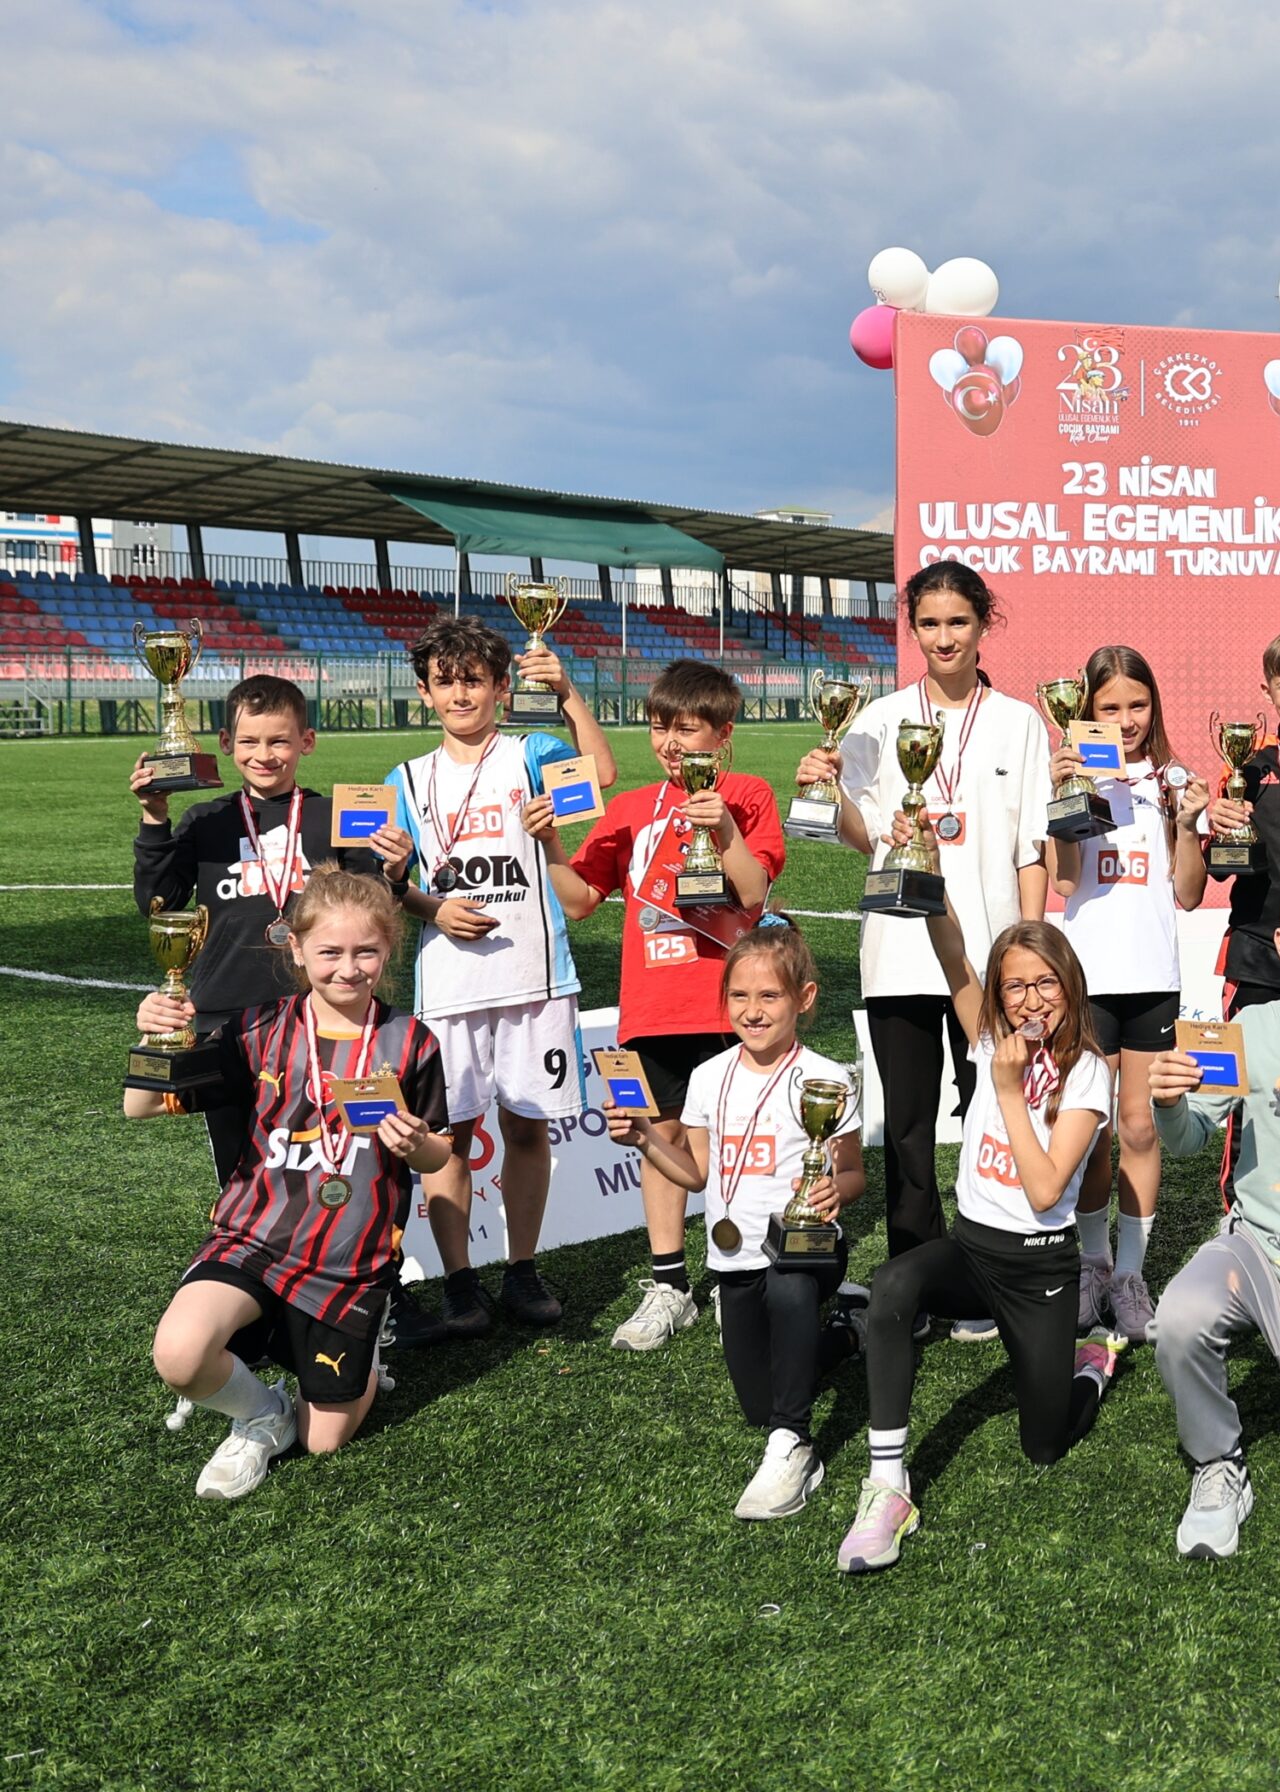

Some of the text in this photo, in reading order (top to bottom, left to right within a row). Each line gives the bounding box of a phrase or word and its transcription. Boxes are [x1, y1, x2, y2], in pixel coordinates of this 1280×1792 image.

[1059, 392, 1118, 414] Nisan
[1085, 424, 1120, 435] BAYRAMI
[1178, 419, 1200, 427] 1911
[1062, 455, 1216, 498] 23 NİSAN
[919, 502, 1069, 542] ULUSAL
[1033, 546, 1157, 576] BAYRAMI
[1101, 854, 1146, 878] 006
[647, 935, 686, 961] 125
[543, 1047, 568, 1090] 9
[1023, 1233, 1065, 1247] NIKE PRO
